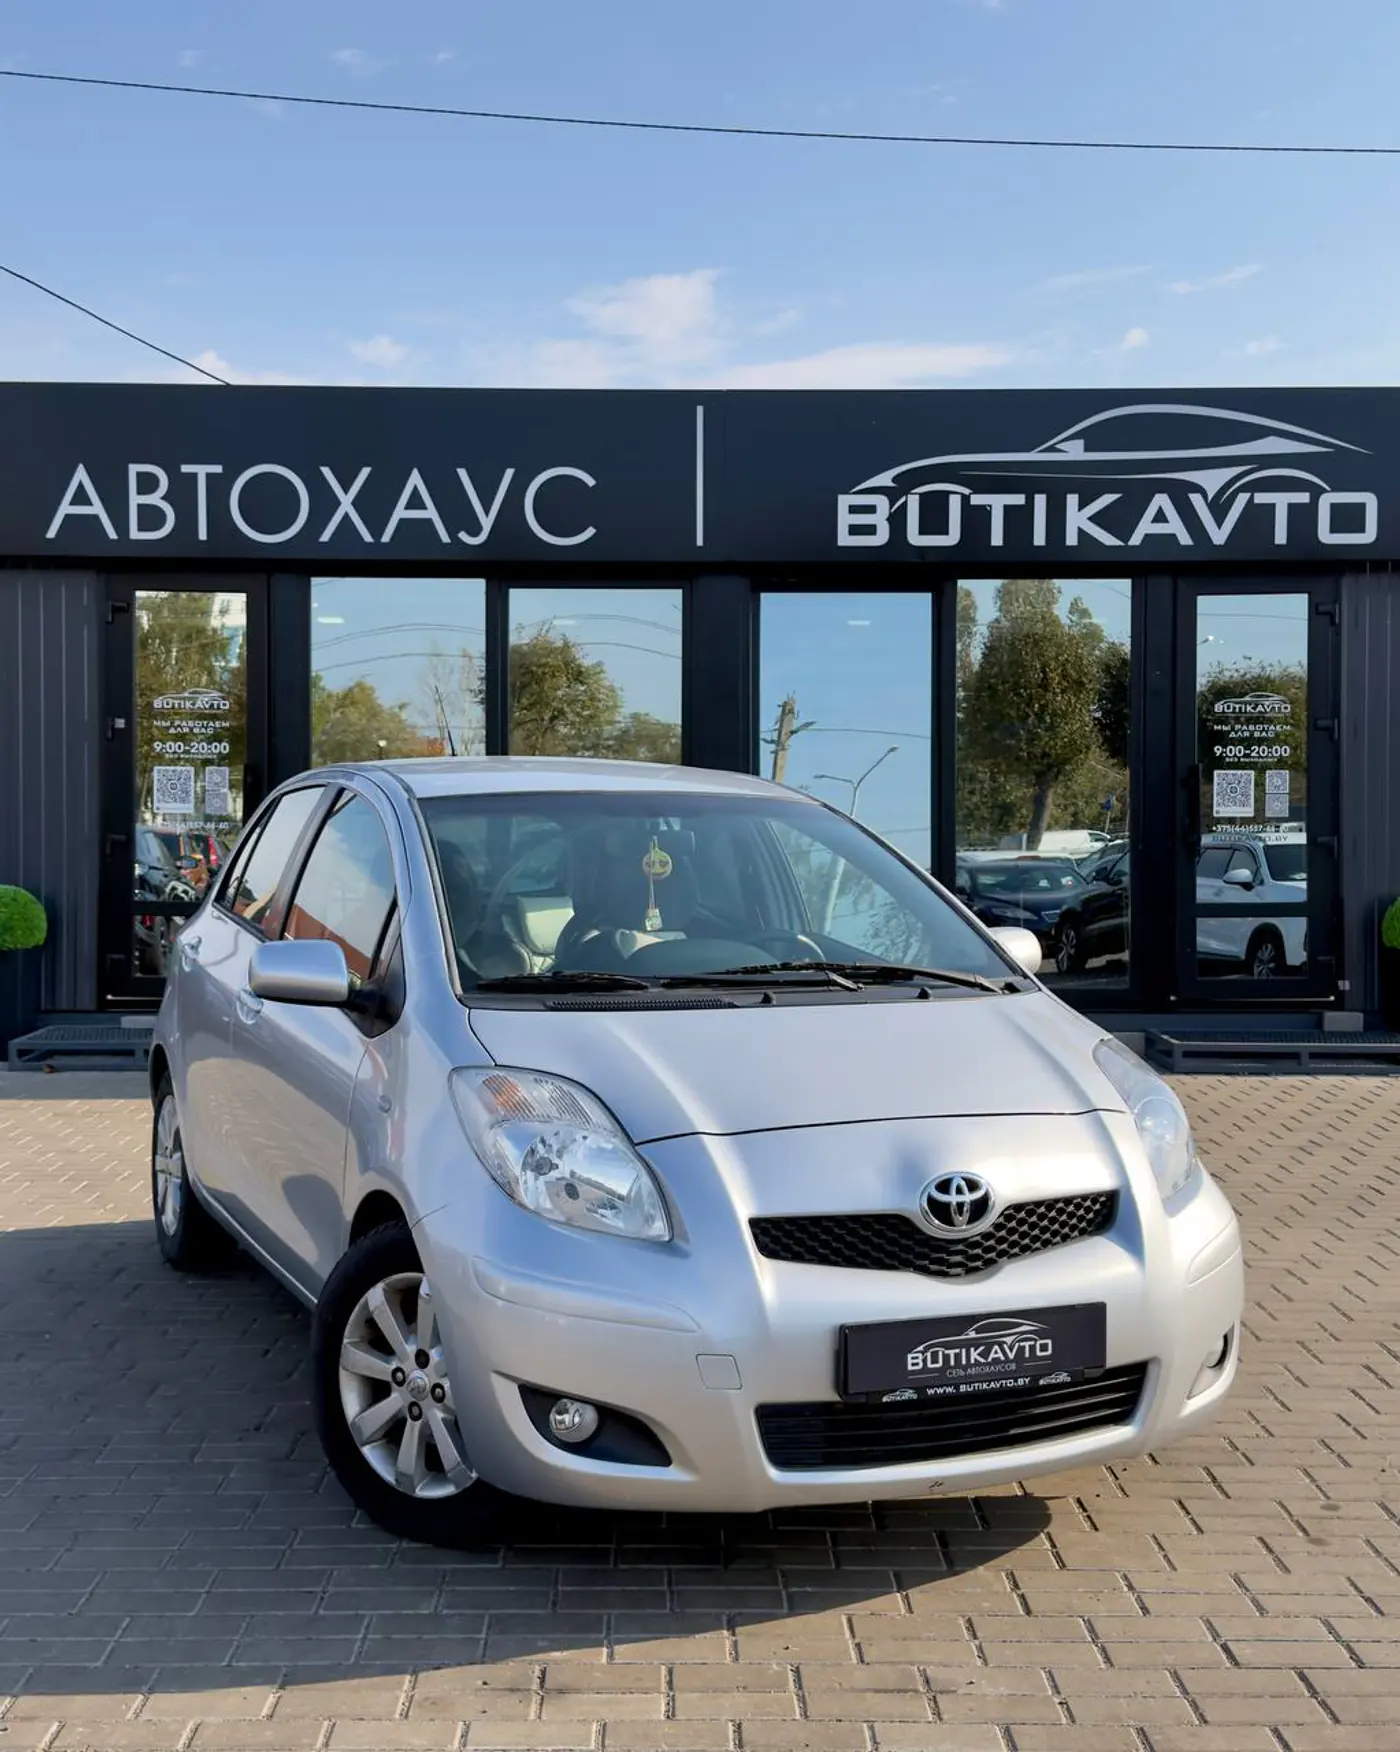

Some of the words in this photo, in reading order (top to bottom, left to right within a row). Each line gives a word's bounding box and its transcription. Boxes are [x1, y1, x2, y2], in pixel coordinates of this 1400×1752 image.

[45, 462, 598, 546] АВТОХАУС
[836, 491, 1379, 547] BUTIKAVTO
[153, 699, 230, 709] BUTIKAVTO
[1214, 703, 1291, 713] BUTIKAVTO
[153, 720, 170, 728] МЫ
[174, 720, 230, 728] РАБОТАЕМ
[153, 741, 230, 754] 9:00-20:00
[1213, 745, 1291, 757] 9:00-20:00
[907, 1339, 1053, 1371] BUTIKAVTO
[966, 1362, 1017, 1375] АВТОХАУСОВ
[959, 1376, 1031, 1393] BUTIKAVTO.BY
